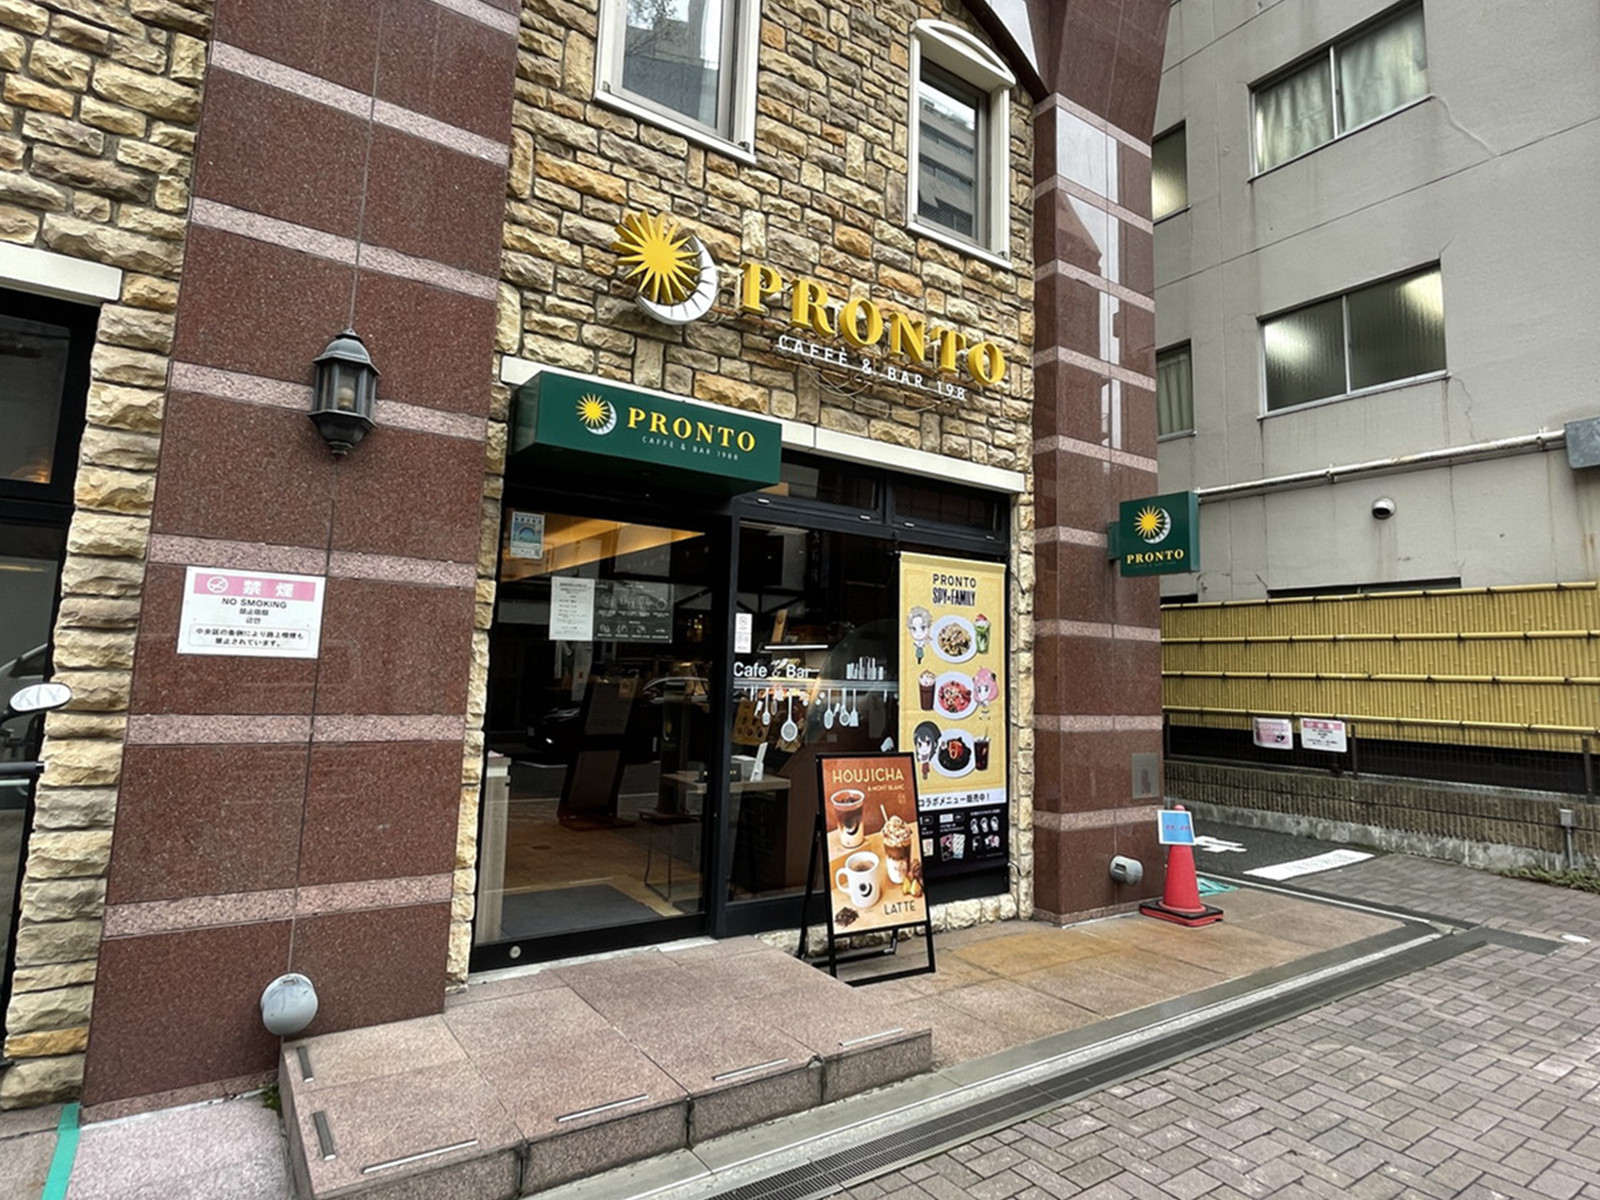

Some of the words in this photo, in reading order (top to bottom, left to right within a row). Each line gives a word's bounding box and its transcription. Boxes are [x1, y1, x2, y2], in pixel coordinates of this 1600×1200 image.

[738, 260, 1007, 386] PRONTO
[861, 358, 873, 374] &
[887, 366, 924, 388] BAR
[627, 406, 756, 452] PRONTO
[680, 442, 687, 451] &
[692, 445, 711, 455] BAR
[1126, 548, 1185, 565] PRONTO
[932, 573, 977, 588] PRONTO
[221, 598, 238, 606] NO
[240, 598, 287, 609] SMOKING
[733, 661, 768, 678] Cafe
[786, 664, 811, 678] Bar
[832, 768, 904, 784] HOUJICHA
[884, 900, 916, 915] LATTE
